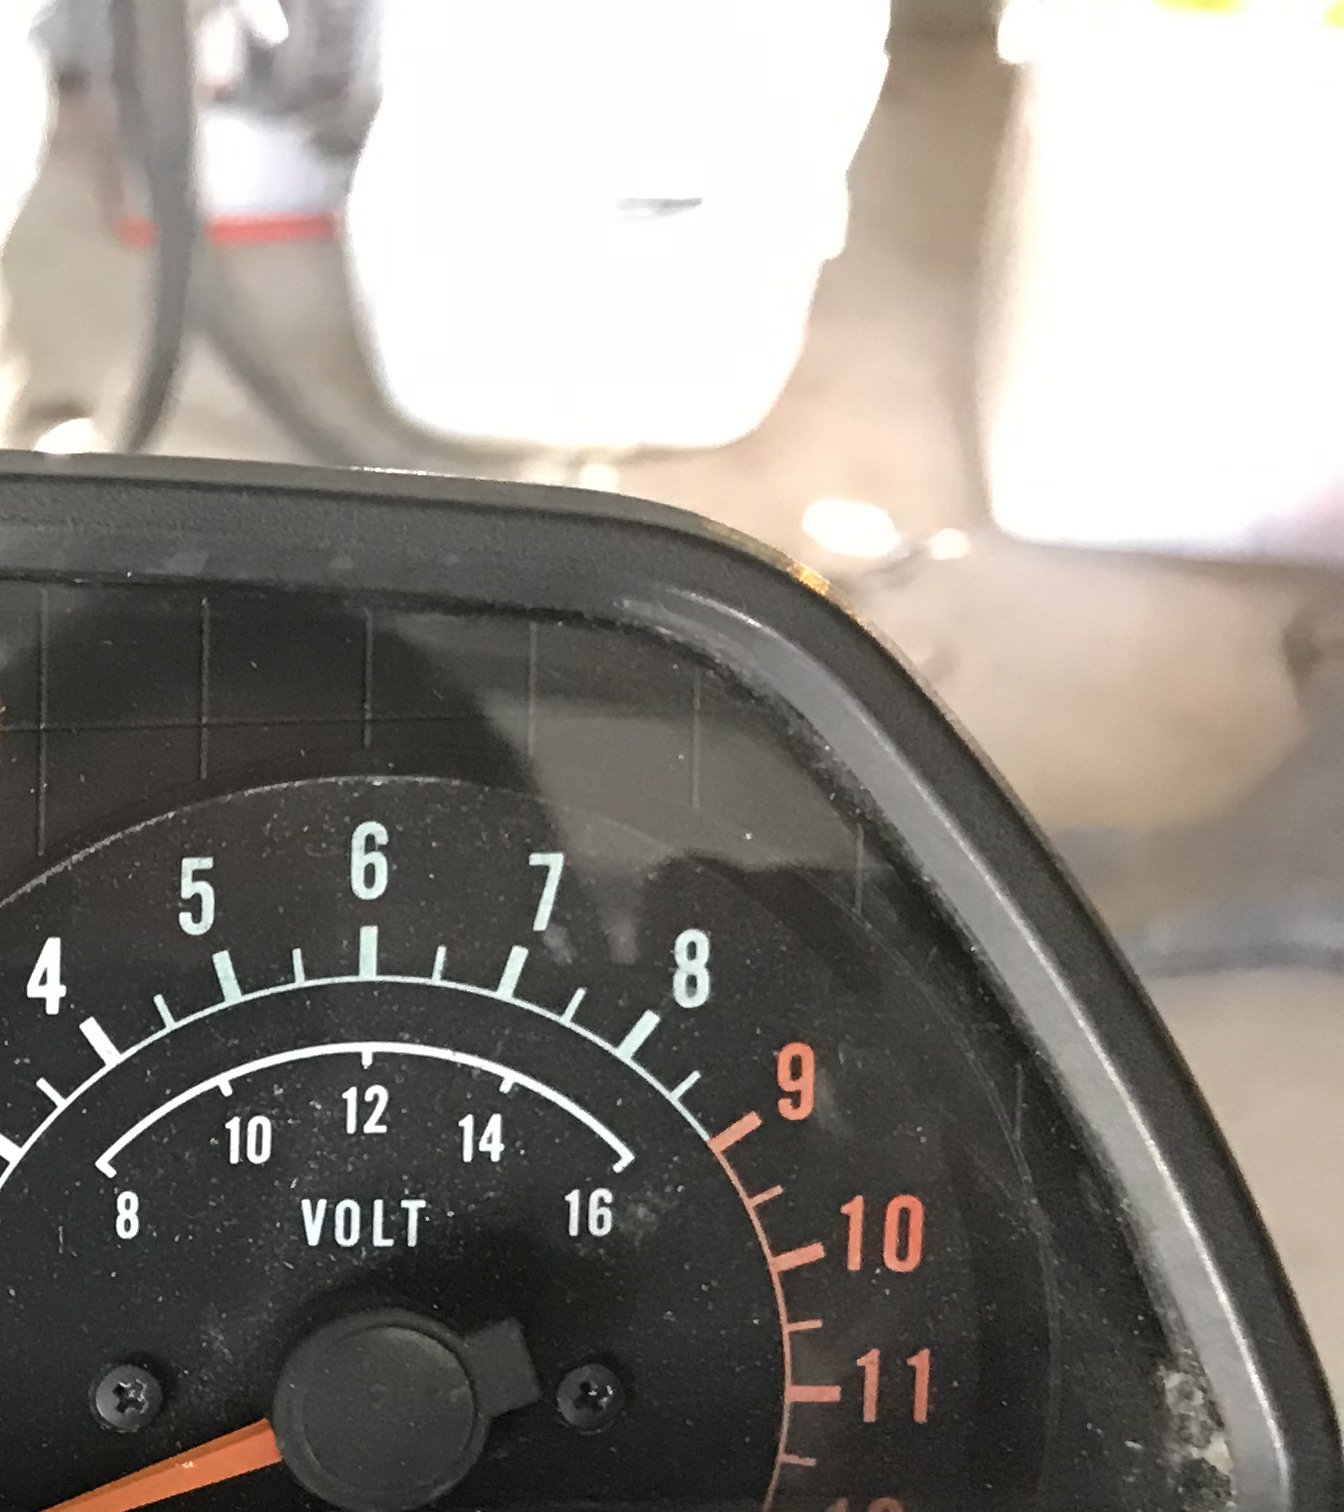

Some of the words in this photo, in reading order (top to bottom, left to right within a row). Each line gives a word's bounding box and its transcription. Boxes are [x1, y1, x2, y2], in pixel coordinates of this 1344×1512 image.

[177, 856, 215, 936] 5
[350, 820, 389, 900] 6
[528, 852, 565, 931] 7
[26, 936, 67, 1015] 4
[672, 928, 711, 1009] 8
[341, 1084, 389, 1135] 12
[776, 1041, 815, 1121] 9
[224, 1114, 273, 1164] 10
[458, 1112, 506, 1163] 14
[115, 1190, 140, 1239] 8
[301, 1197, 427, 1248] VOLT
[564, 1187, 614, 1236] 16
[839, 1193, 925, 1272] 10
[855, 1347, 932, 1423] 11
